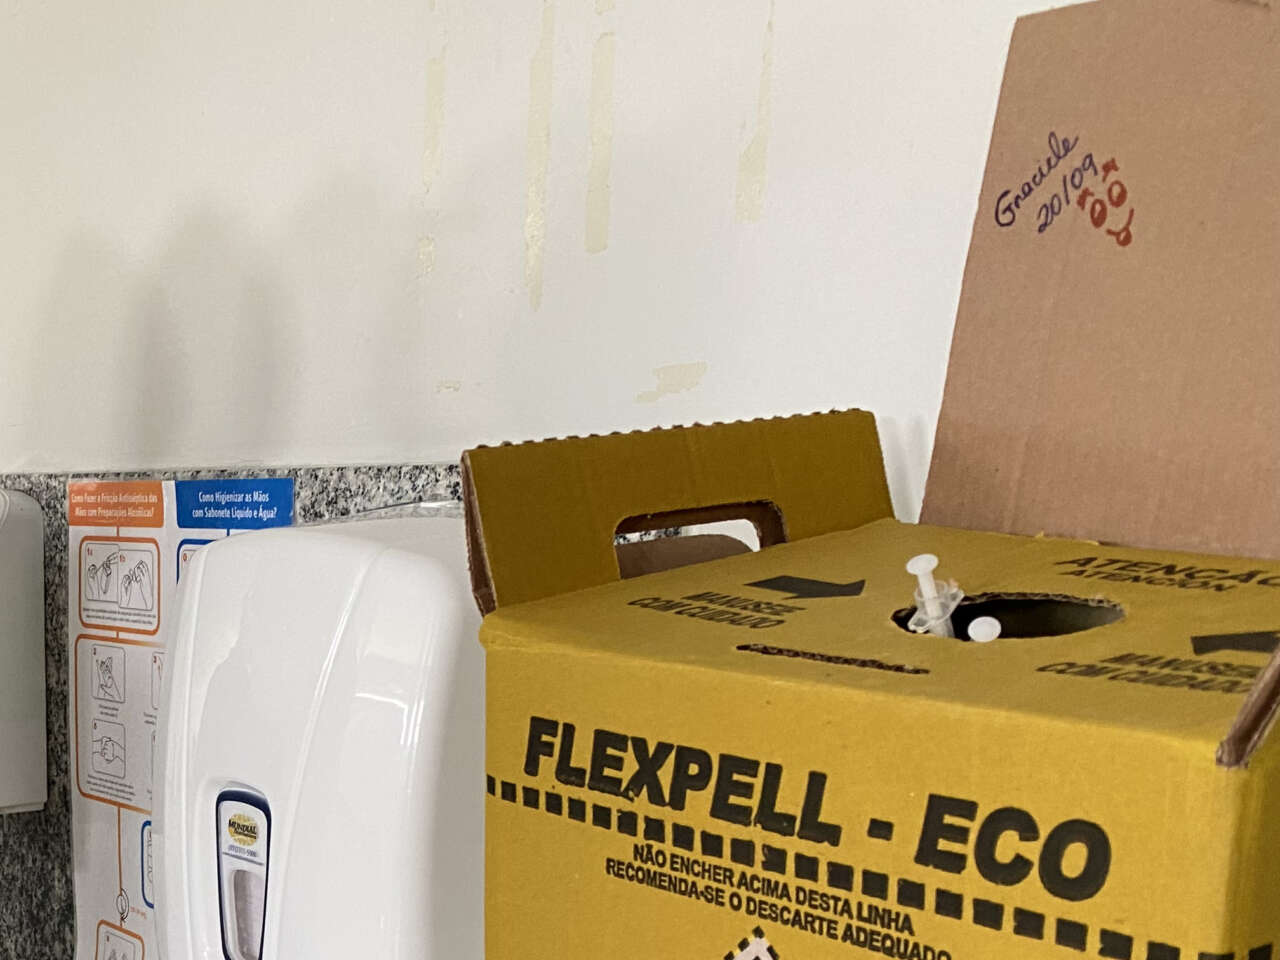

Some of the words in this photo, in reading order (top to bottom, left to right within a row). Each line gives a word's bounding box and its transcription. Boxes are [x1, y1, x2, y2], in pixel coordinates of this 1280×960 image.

[1037, 152, 1098, 234] 20/09
[192, 508, 203, 517] com
[204, 507, 230, 518] Sabonete
[258, 505, 277, 521] Água?
[198, 491, 214, 503] Como
[215, 491, 243, 505] Higienizar
[244, 494, 252, 502] as
[253, 491, 269, 502] Mãos
[626, 597, 693, 612] COM
[674, 606, 786, 629] CUIDADO
[228, 818, 257, 835] MUNDIAL
[524, 715, 843, 848] FLEXPELL
[914, 793, 1112, 902] ECO
[605, 857, 726, 907] RECOMENDA-SE
[729, 891, 743, 912] O
[745, 895, 839, 941] DESCARTE
[633, 843, 667, 868] NÃO
[669, 852, 735, 888] ENCHER
[736, 871, 792, 903] ACIMA
[795, 885, 854, 921] DESTA
[856, 900, 916, 937] LINHA
